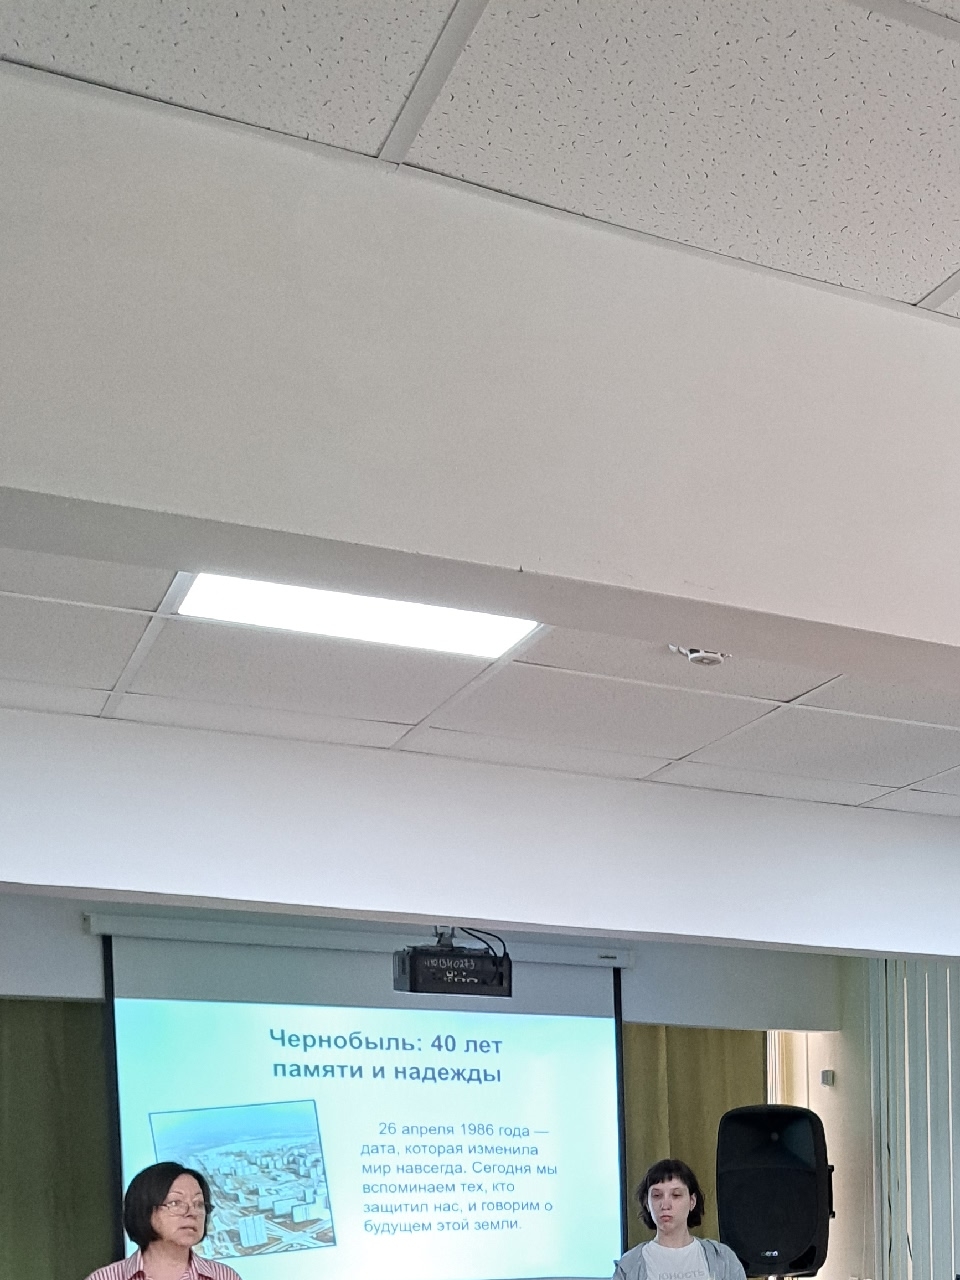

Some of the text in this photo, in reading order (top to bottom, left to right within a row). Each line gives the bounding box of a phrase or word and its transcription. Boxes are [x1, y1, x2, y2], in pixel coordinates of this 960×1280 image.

[269, 1028, 503, 1054] Чернобыль: 40 лет
[272, 1063, 501, 1084] памяти и надежды
[378, 1122, 397, 1135] 26
[401, 1123, 455, 1138] апреля
[460, 1123, 494, 1136] 1986
[498, 1125, 530, 1138] года
[360, 1143, 539, 1157] дата, которая изменила
[361, 1161, 557, 1176] мир навсегда. Сегодня мы
[362, 1181, 515, 1194] вспоминаем тех, кто
[363, 1201, 553, 1214] защитил нас, и говорим о
[364, 1218, 522, 1235] будущем этой земли.
